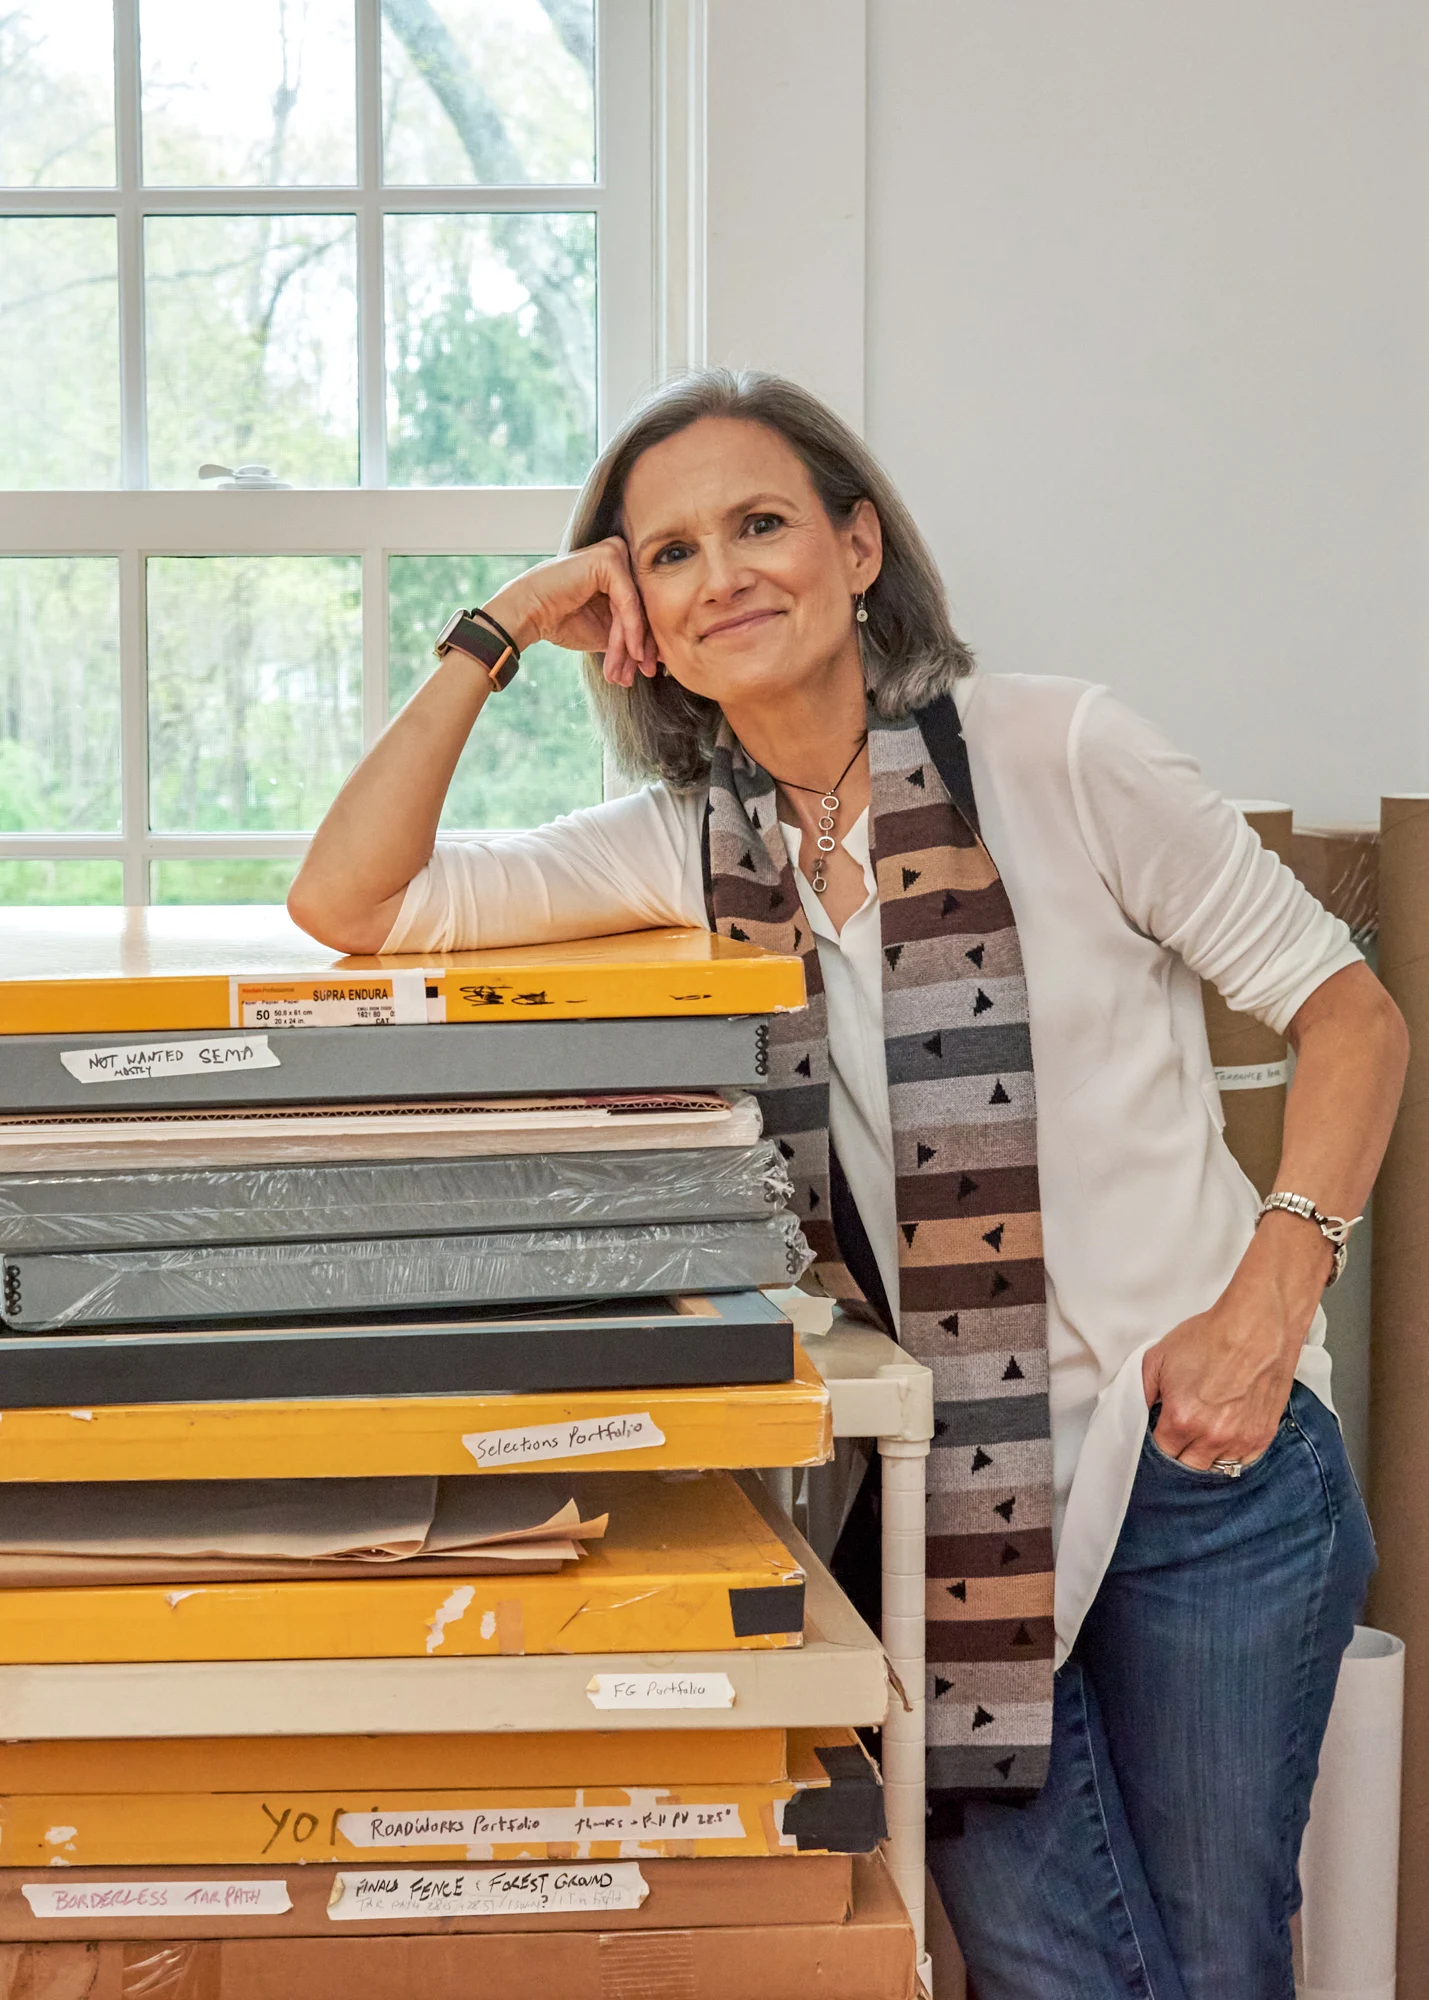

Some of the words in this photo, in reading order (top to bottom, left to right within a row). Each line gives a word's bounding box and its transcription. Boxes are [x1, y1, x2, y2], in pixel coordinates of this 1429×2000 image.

[312, 989, 346, 1002] SUPRA
[348, 988, 389, 1001] ENDURA
[256, 1009, 270, 1021] 50
[89, 1053, 119, 1069] NOT
[126, 1049, 184, 1065] WANTED
[114, 1066, 152, 1078] MOSTLY
[477, 1437, 559, 1459] Selections
[568, 1419, 643, 1448] Portfolio
[614, 1682, 637, 1697] FG
[646, 1680, 706, 1697] Portfolio
[409, 1876, 465, 1902] FENCE
[488, 1872, 550, 1894] FOREST
[553, 1872, 613, 1890] GROUND
[51, 1888, 168, 1911] BORDERLESS
